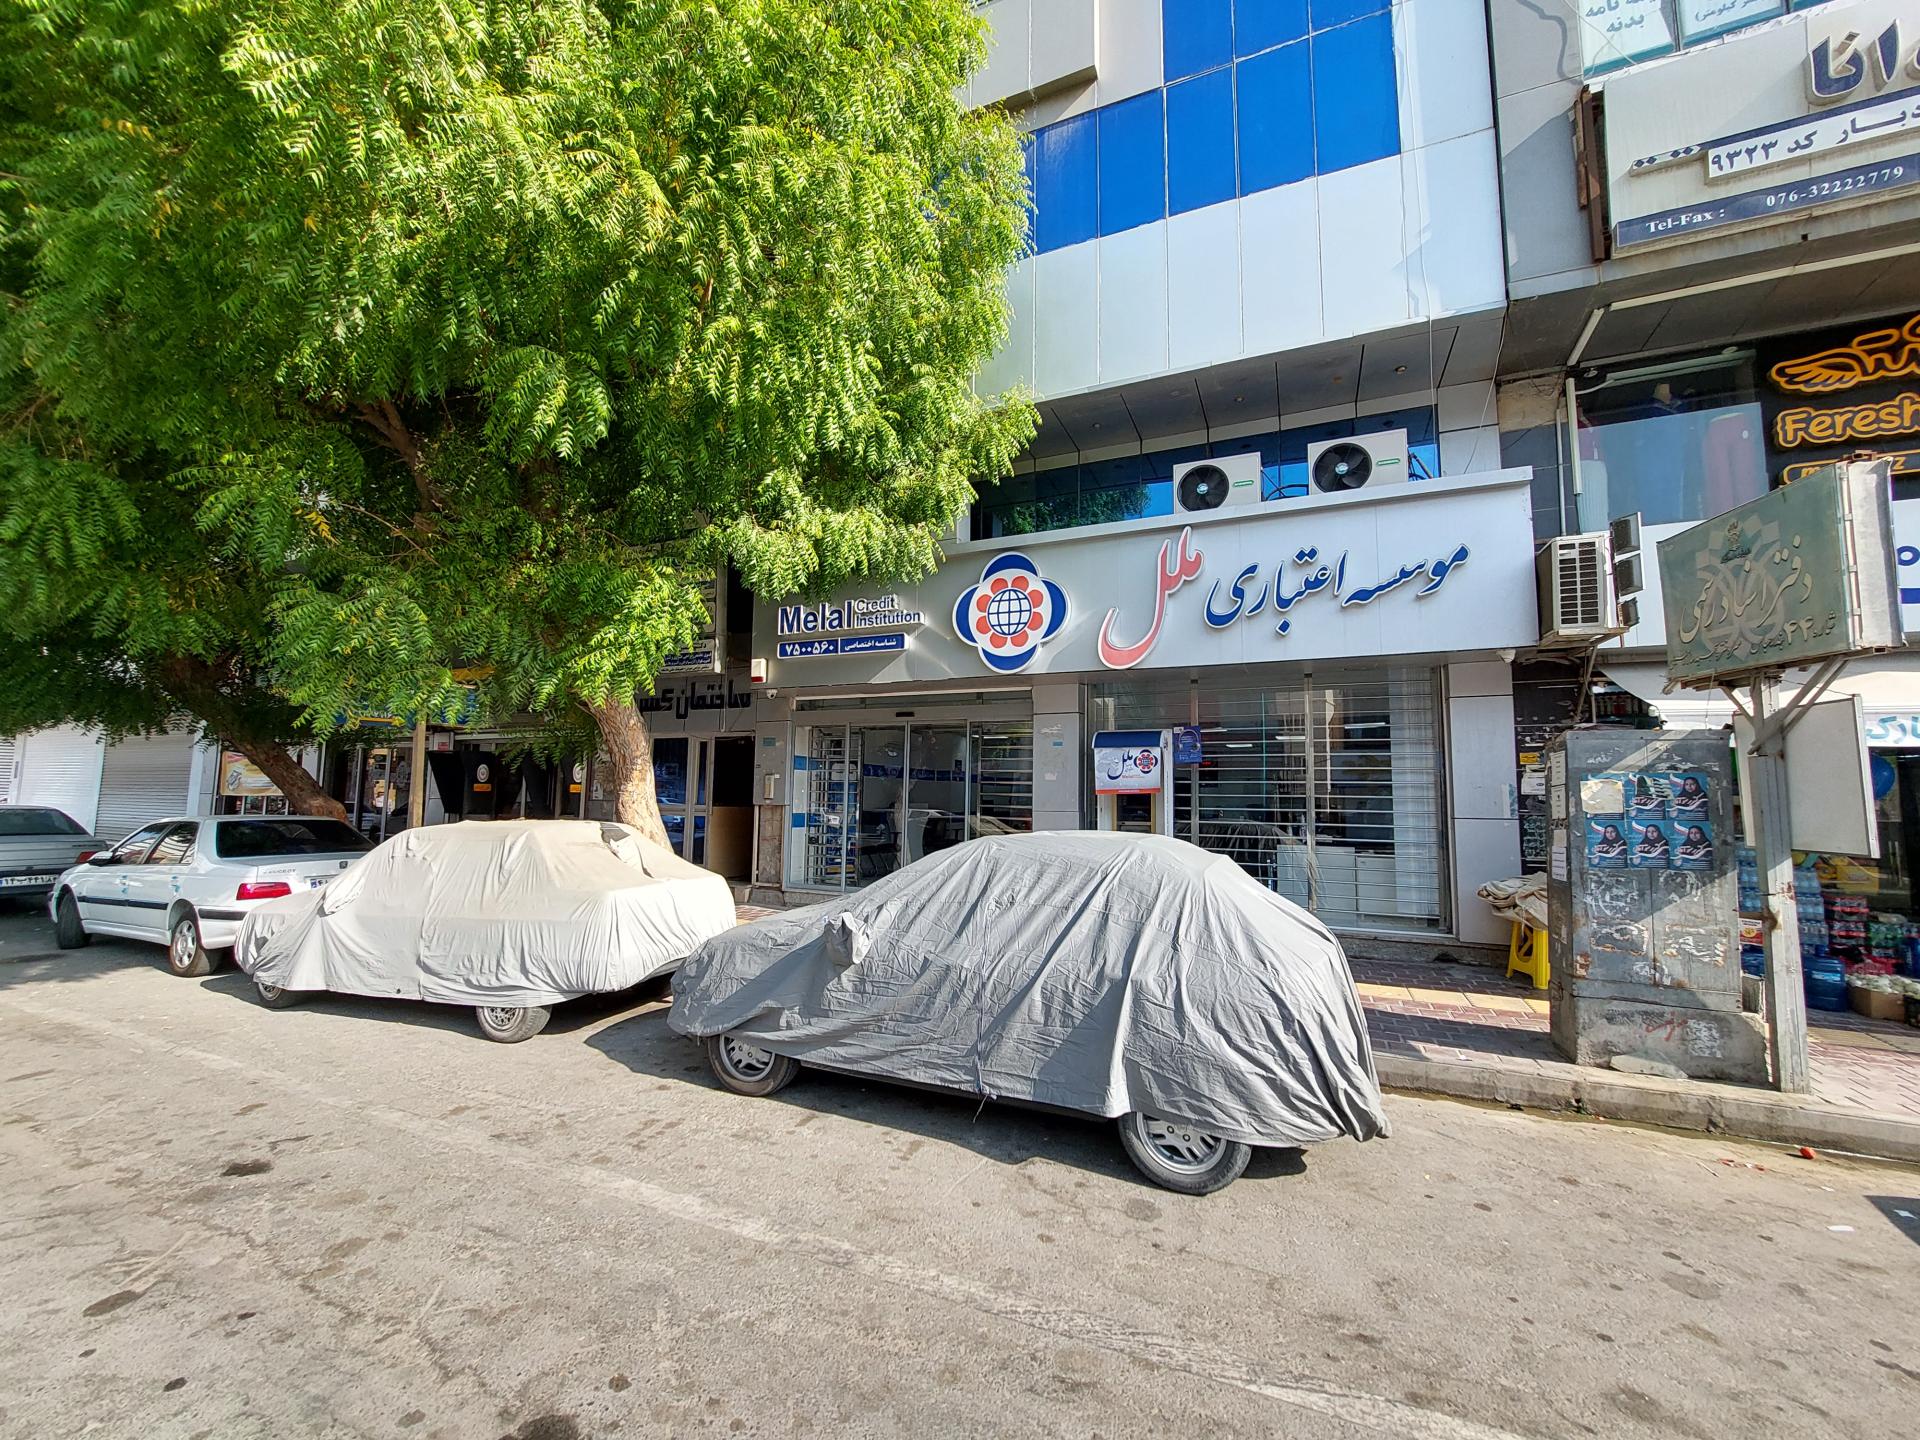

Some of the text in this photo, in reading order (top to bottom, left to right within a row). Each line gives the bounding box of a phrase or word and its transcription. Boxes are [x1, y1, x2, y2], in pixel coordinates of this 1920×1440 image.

[1606, 13, 1646, 34] بدنه
[1711, 139, 1779, 172] ۹۳۲۳
[1787, 129, 1818, 154] کد
[1646, 210, 1714, 233] Tel-Fax
[1766, 166, 1904, 207] 076-32222779
[1098, 526, 1470, 670] موسسه اعتباری ملل
[1718, 560, 1767, 625] اسناد
[1757, 535, 1813, 628] دفتر
[778, 596, 896, 635] Melal Credit
[855, 610, 922, 628] Institution
[785, 641, 834, 656] ۷۵۰۰۵۶۰
[875, 638, 897, 648] شناسه
